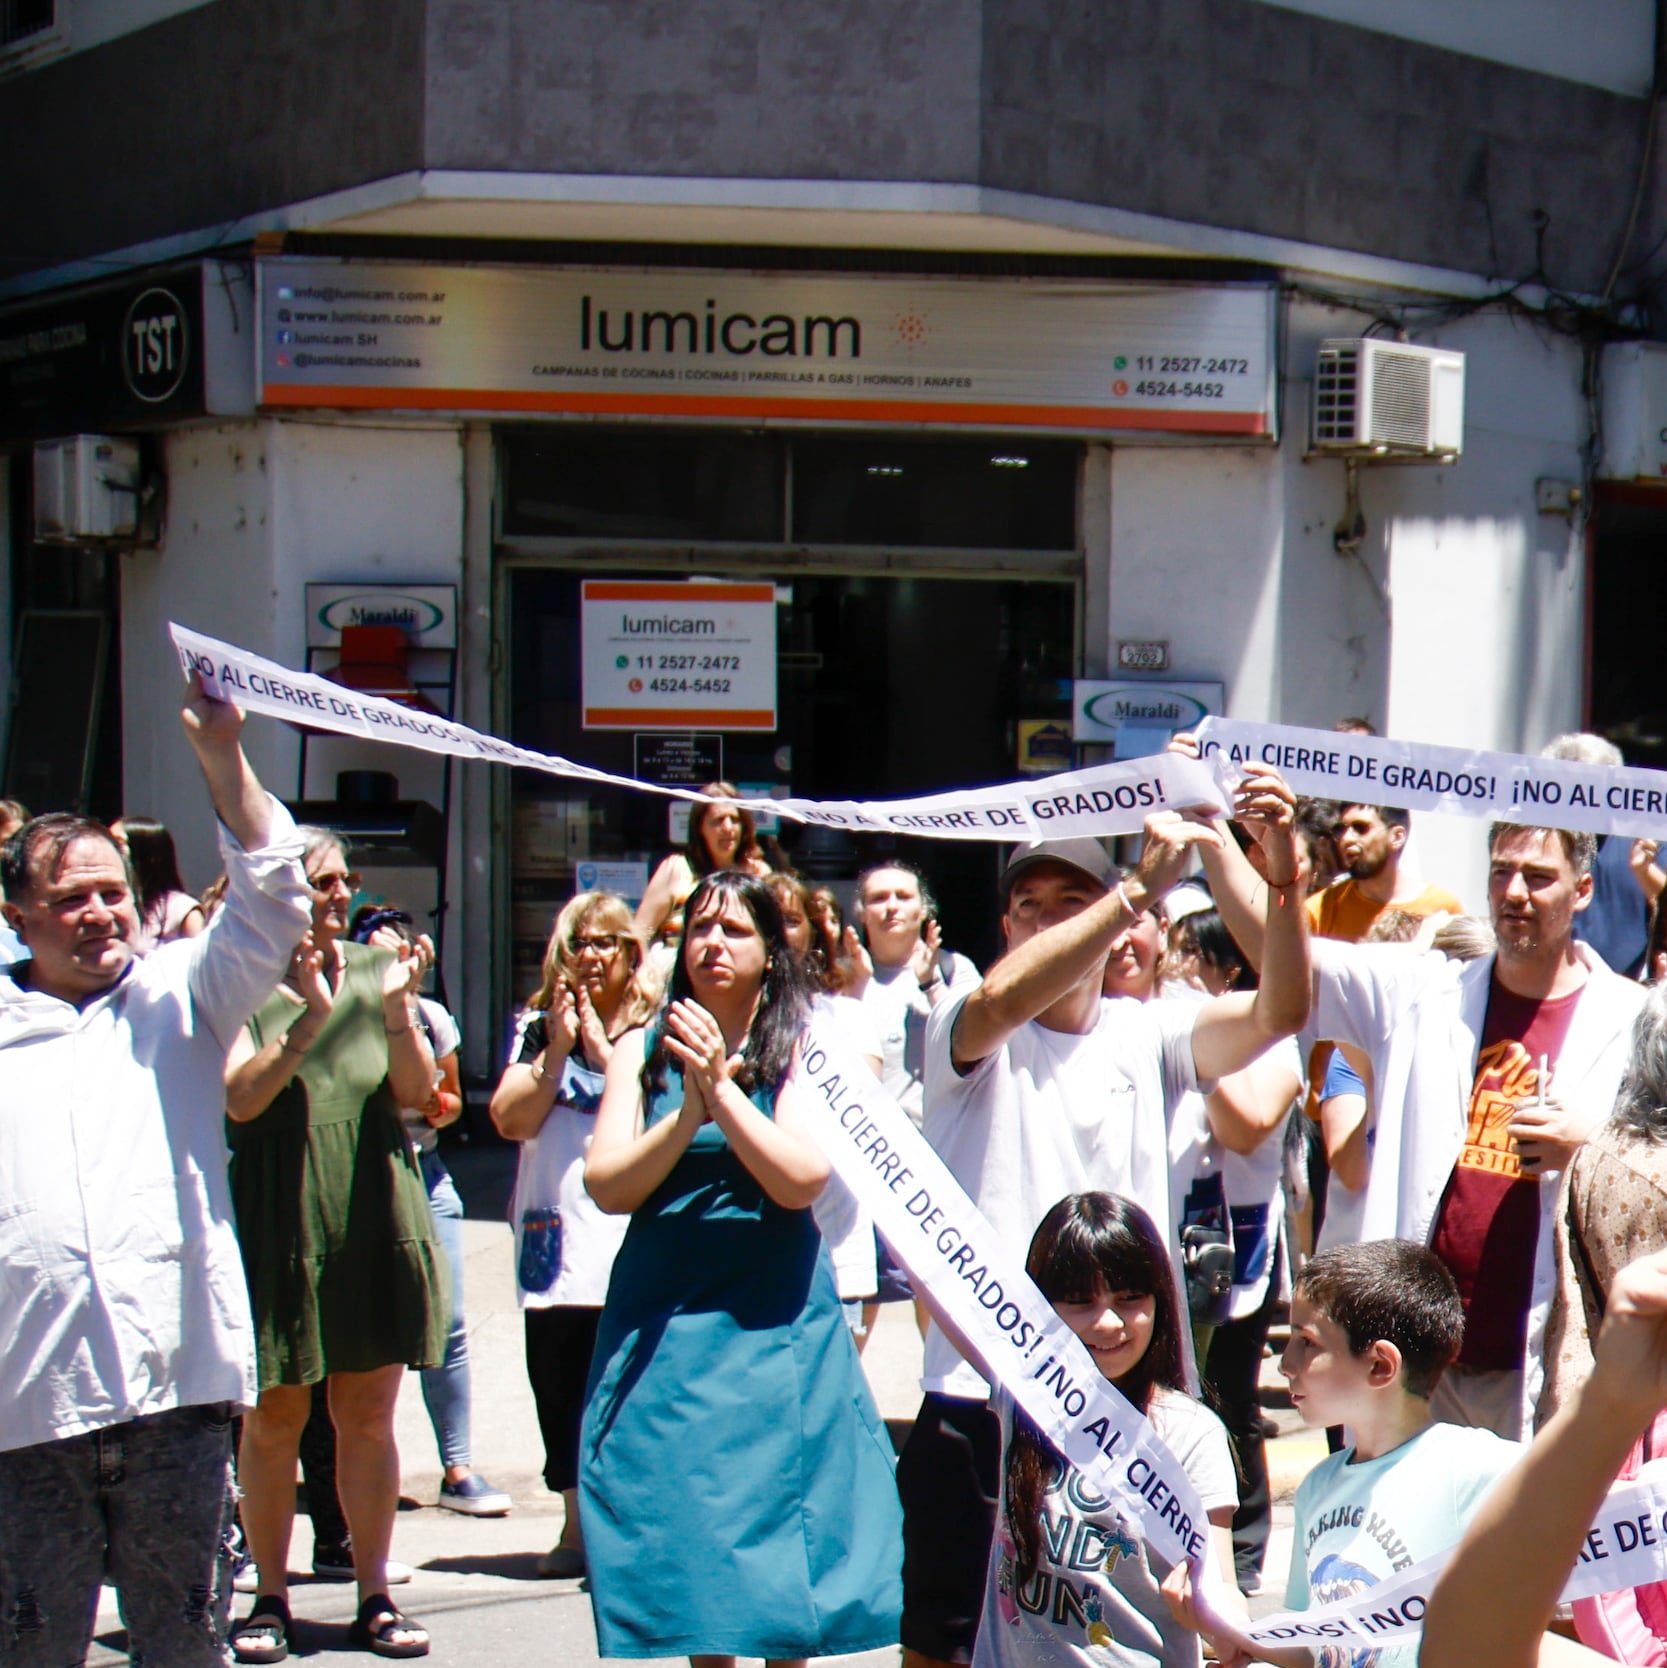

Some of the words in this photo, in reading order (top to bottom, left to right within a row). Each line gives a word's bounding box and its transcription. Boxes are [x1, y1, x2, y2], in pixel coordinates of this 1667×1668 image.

[294, 286, 446, 303] info@lumicam.com.ar
[294, 309, 443, 326] www.lumicam.com.ar
[581, 296, 861, 357] lumicam
[132, 315, 176, 375] TST
[294, 330, 354, 345] lumicam
[293, 353, 421, 369] @lumicamcocinas
[1135, 356, 1154, 371] 11
[1160, 357, 1249, 375] 2527-2472
[532, 365, 600, 377] CAMPANAS
[602, 367, 619, 378] DE
[621, 368, 676, 380] COCINAS
[684, 369, 739, 381] COCINAS
[748, 371, 814, 384] PARRILLAS
[828, 373, 855, 385] GAS
[862, 374, 914, 387] HORNOS
[923, 376, 972, 388] ANAFES
[1135, 382, 1225, 399] 4524-5452
[351, 607, 416, 626] Maraldi
[622, 614, 715, 635] lumicam
[637, 655, 653, 670] 11
[658, 656, 740, 670] 2527-2472
[1127, 653, 1158, 664] 2702
[221, 663, 248, 690] AL
[249, 673, 327, 711] CIERRE
[328, 697, 364, 721] DE
[650, 678, 731, 693] 4524-5452
[1114, 701, 1180, 719] Maraldi
[1262, 743, 1340, 775] CIERRE
[1348, 755, 1378, 780] DE
[1383, 764, 1496, 800] GRADOS!
[1512, 779, 1562, 805] ¡NO
[1569, 784, 1601, 808] AL
[889, 811, 985, 829] CIERRE
[985, 807, 1027, 827] DE
[1032, 778, 1166, 820] GRADOS!
[817, 1073, 849, 1112] AL
[839, 1103, 915, 1194] CIERRE
[904, 1188, 945, 1235] DE
[936, 1226, 1044, 1358] GRADOS!
[1034, 1355, 1087, 1418] ¡NO
[1082, 1416, 1122, 1461] AL
[1126, 1457, 1206, 1560] CIERRE
[1613, 1512, 1658, 1553] DE
[1249, 1619, 1359, 1641] ADOS!
[1358, 1594, 1427, 1634] ¡NO
